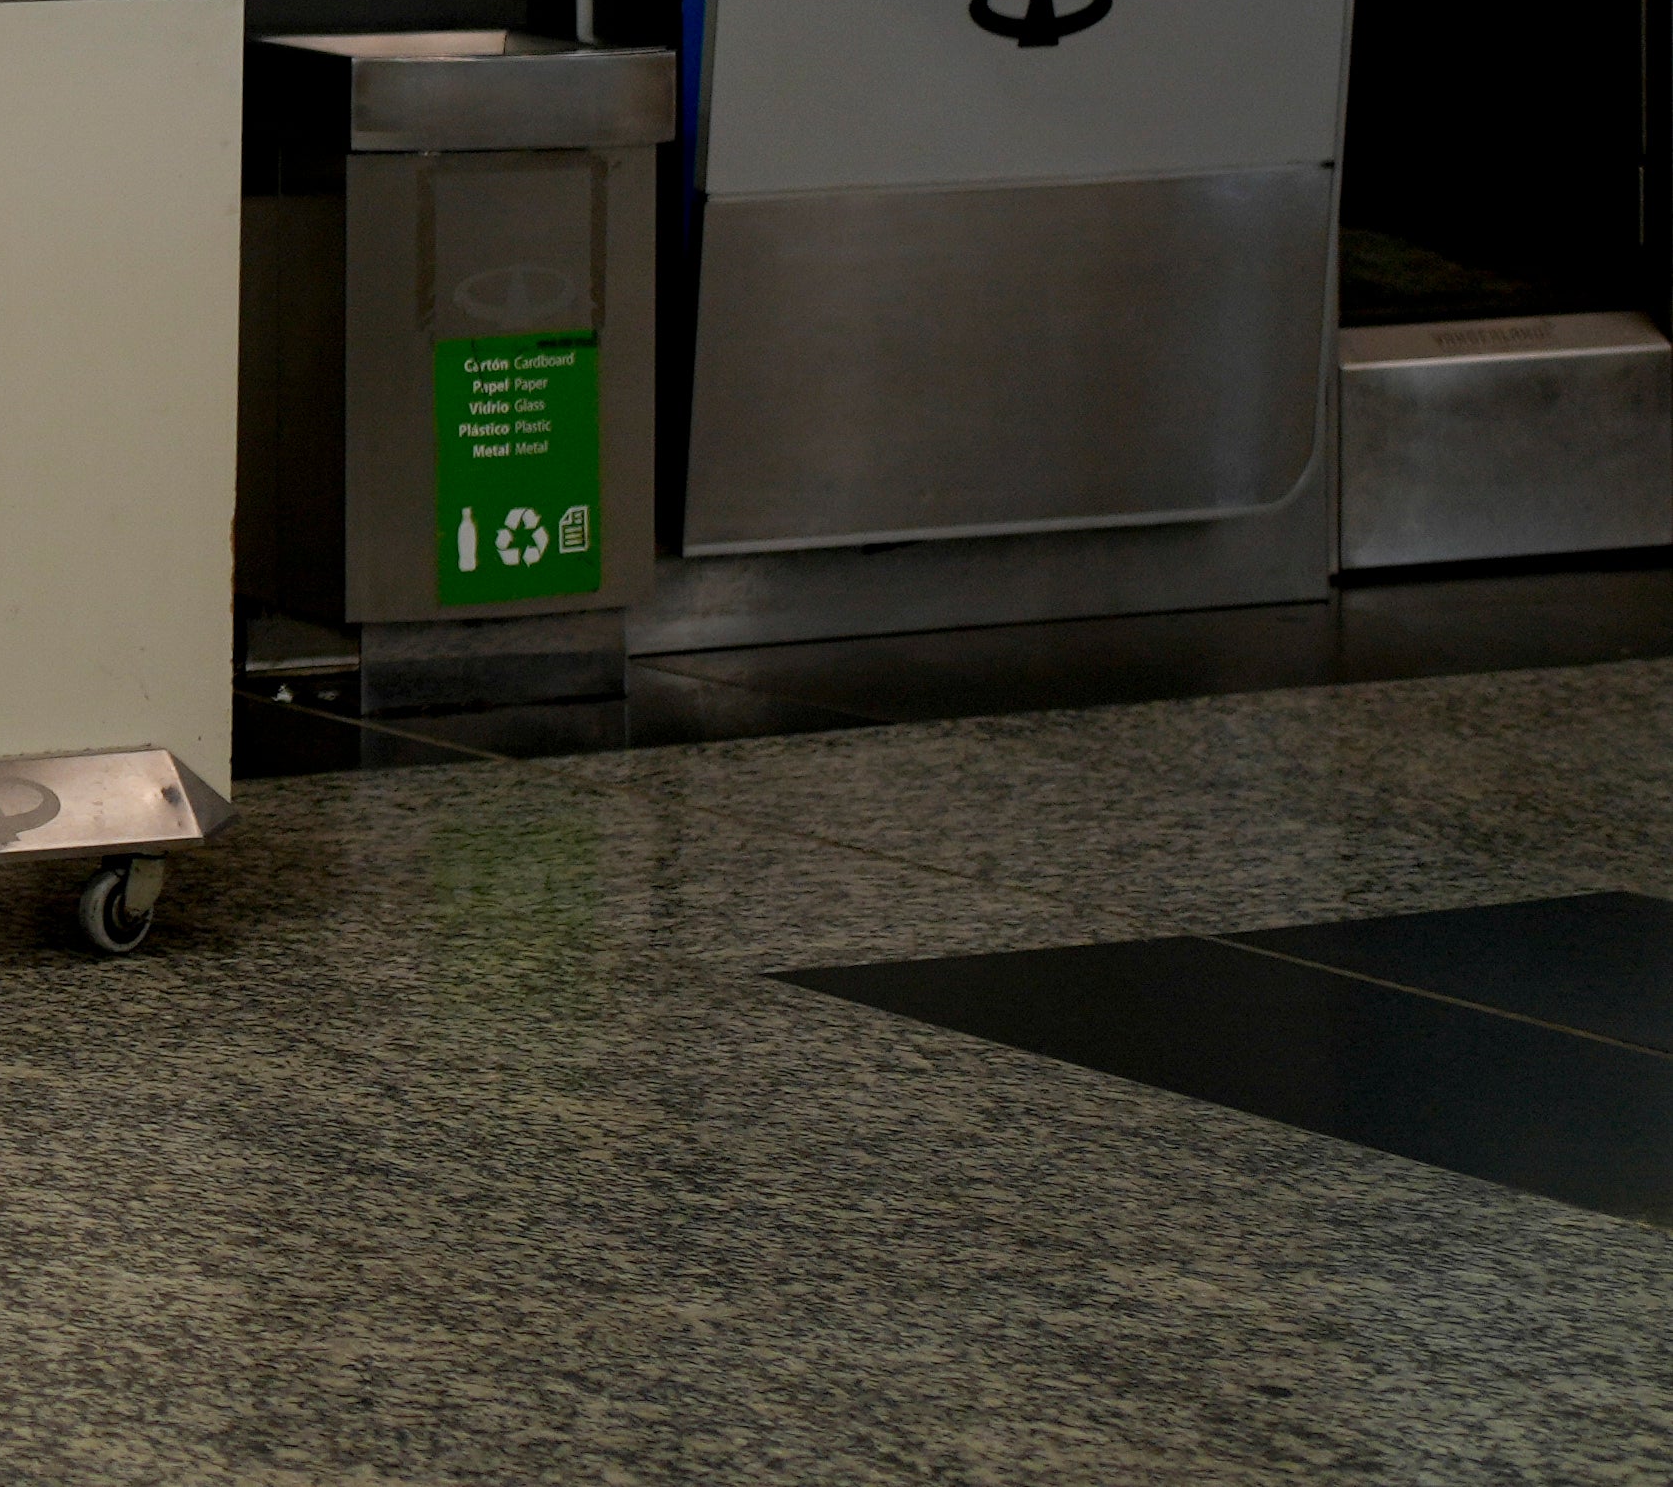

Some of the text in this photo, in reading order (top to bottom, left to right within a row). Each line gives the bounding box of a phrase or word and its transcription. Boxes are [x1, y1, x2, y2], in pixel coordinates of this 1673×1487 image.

[463, 351, 576, 373] Cartón Cardboard
[513, 376, 549, 393] Paper
[468, 398, 547, 416] Vidrio Glass
[458, 418, 553, 438] Plástico Plastic
[472, 439, 549, 459] Metal Metal
